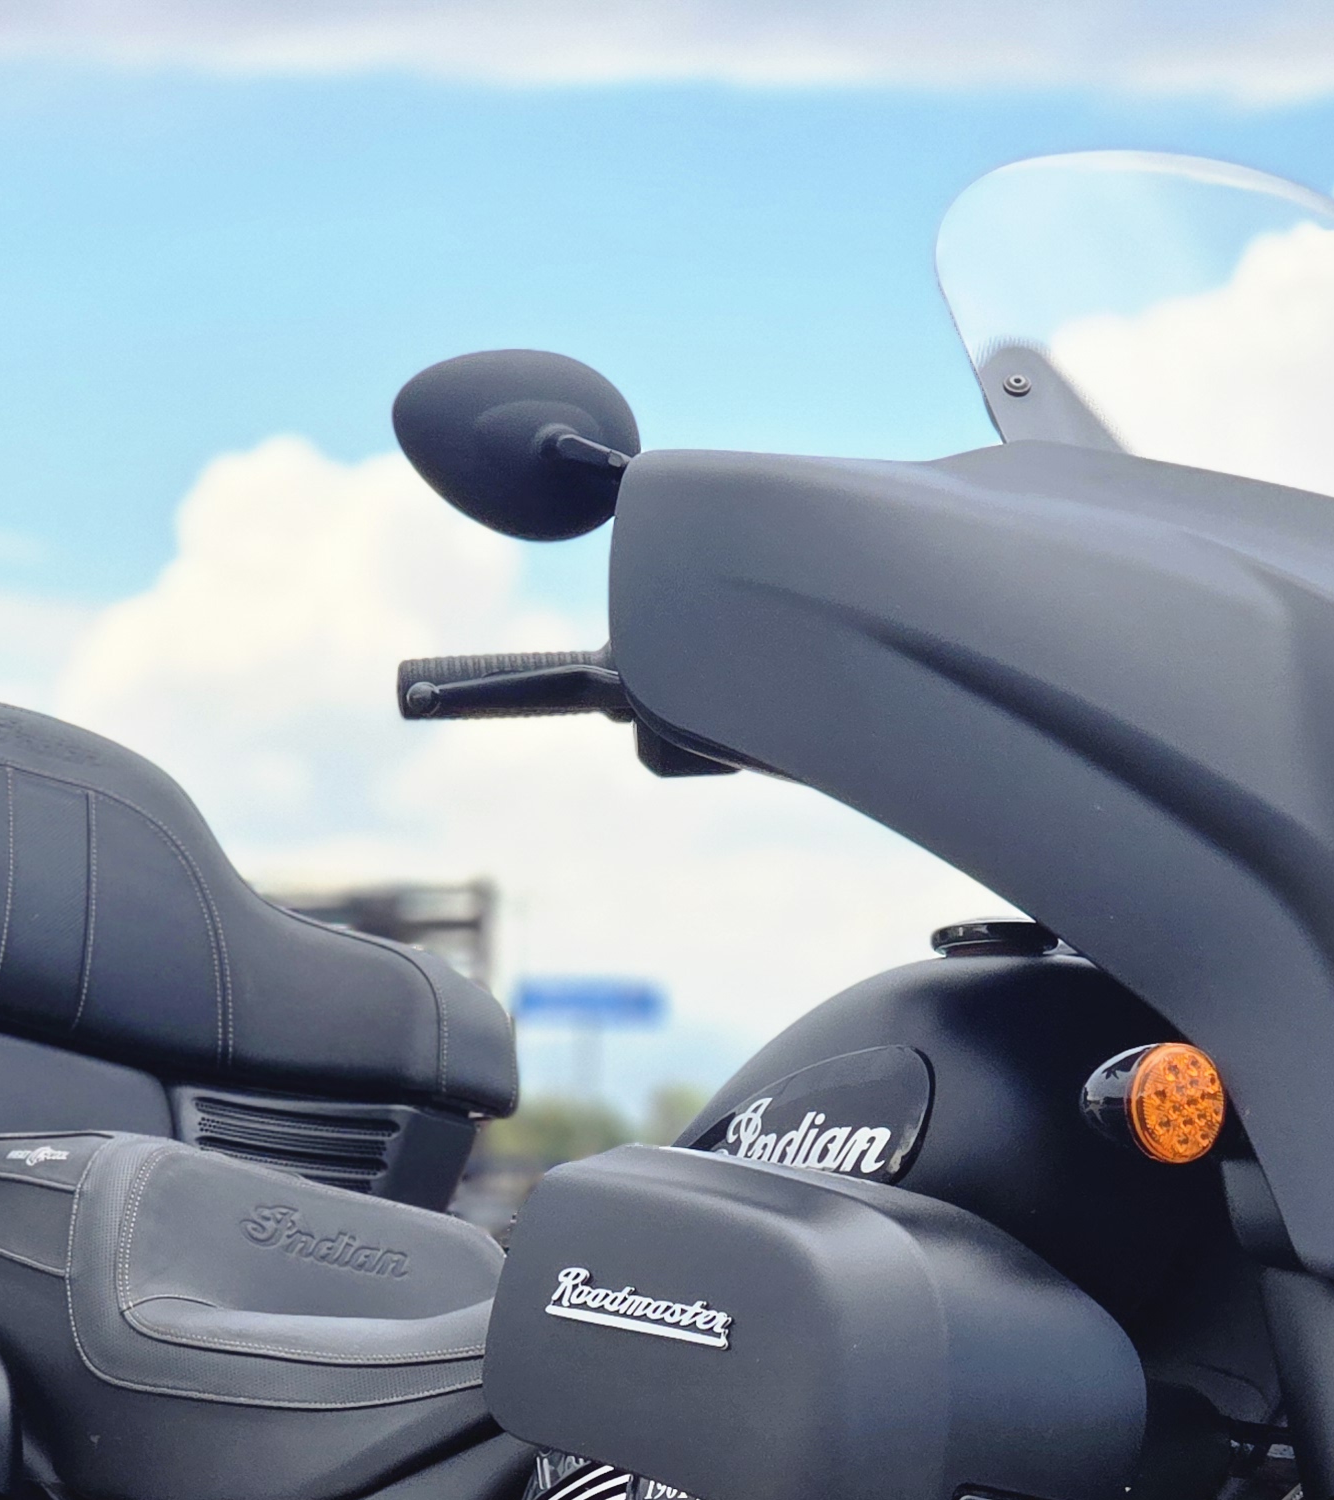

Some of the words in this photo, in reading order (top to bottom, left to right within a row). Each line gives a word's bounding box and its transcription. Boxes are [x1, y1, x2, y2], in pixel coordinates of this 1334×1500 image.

[716, 1098, 891, 1173] Indian
[240, 1205, 409, 1280] Indian
[551, 1267, 732, 1334] Roadmaster
